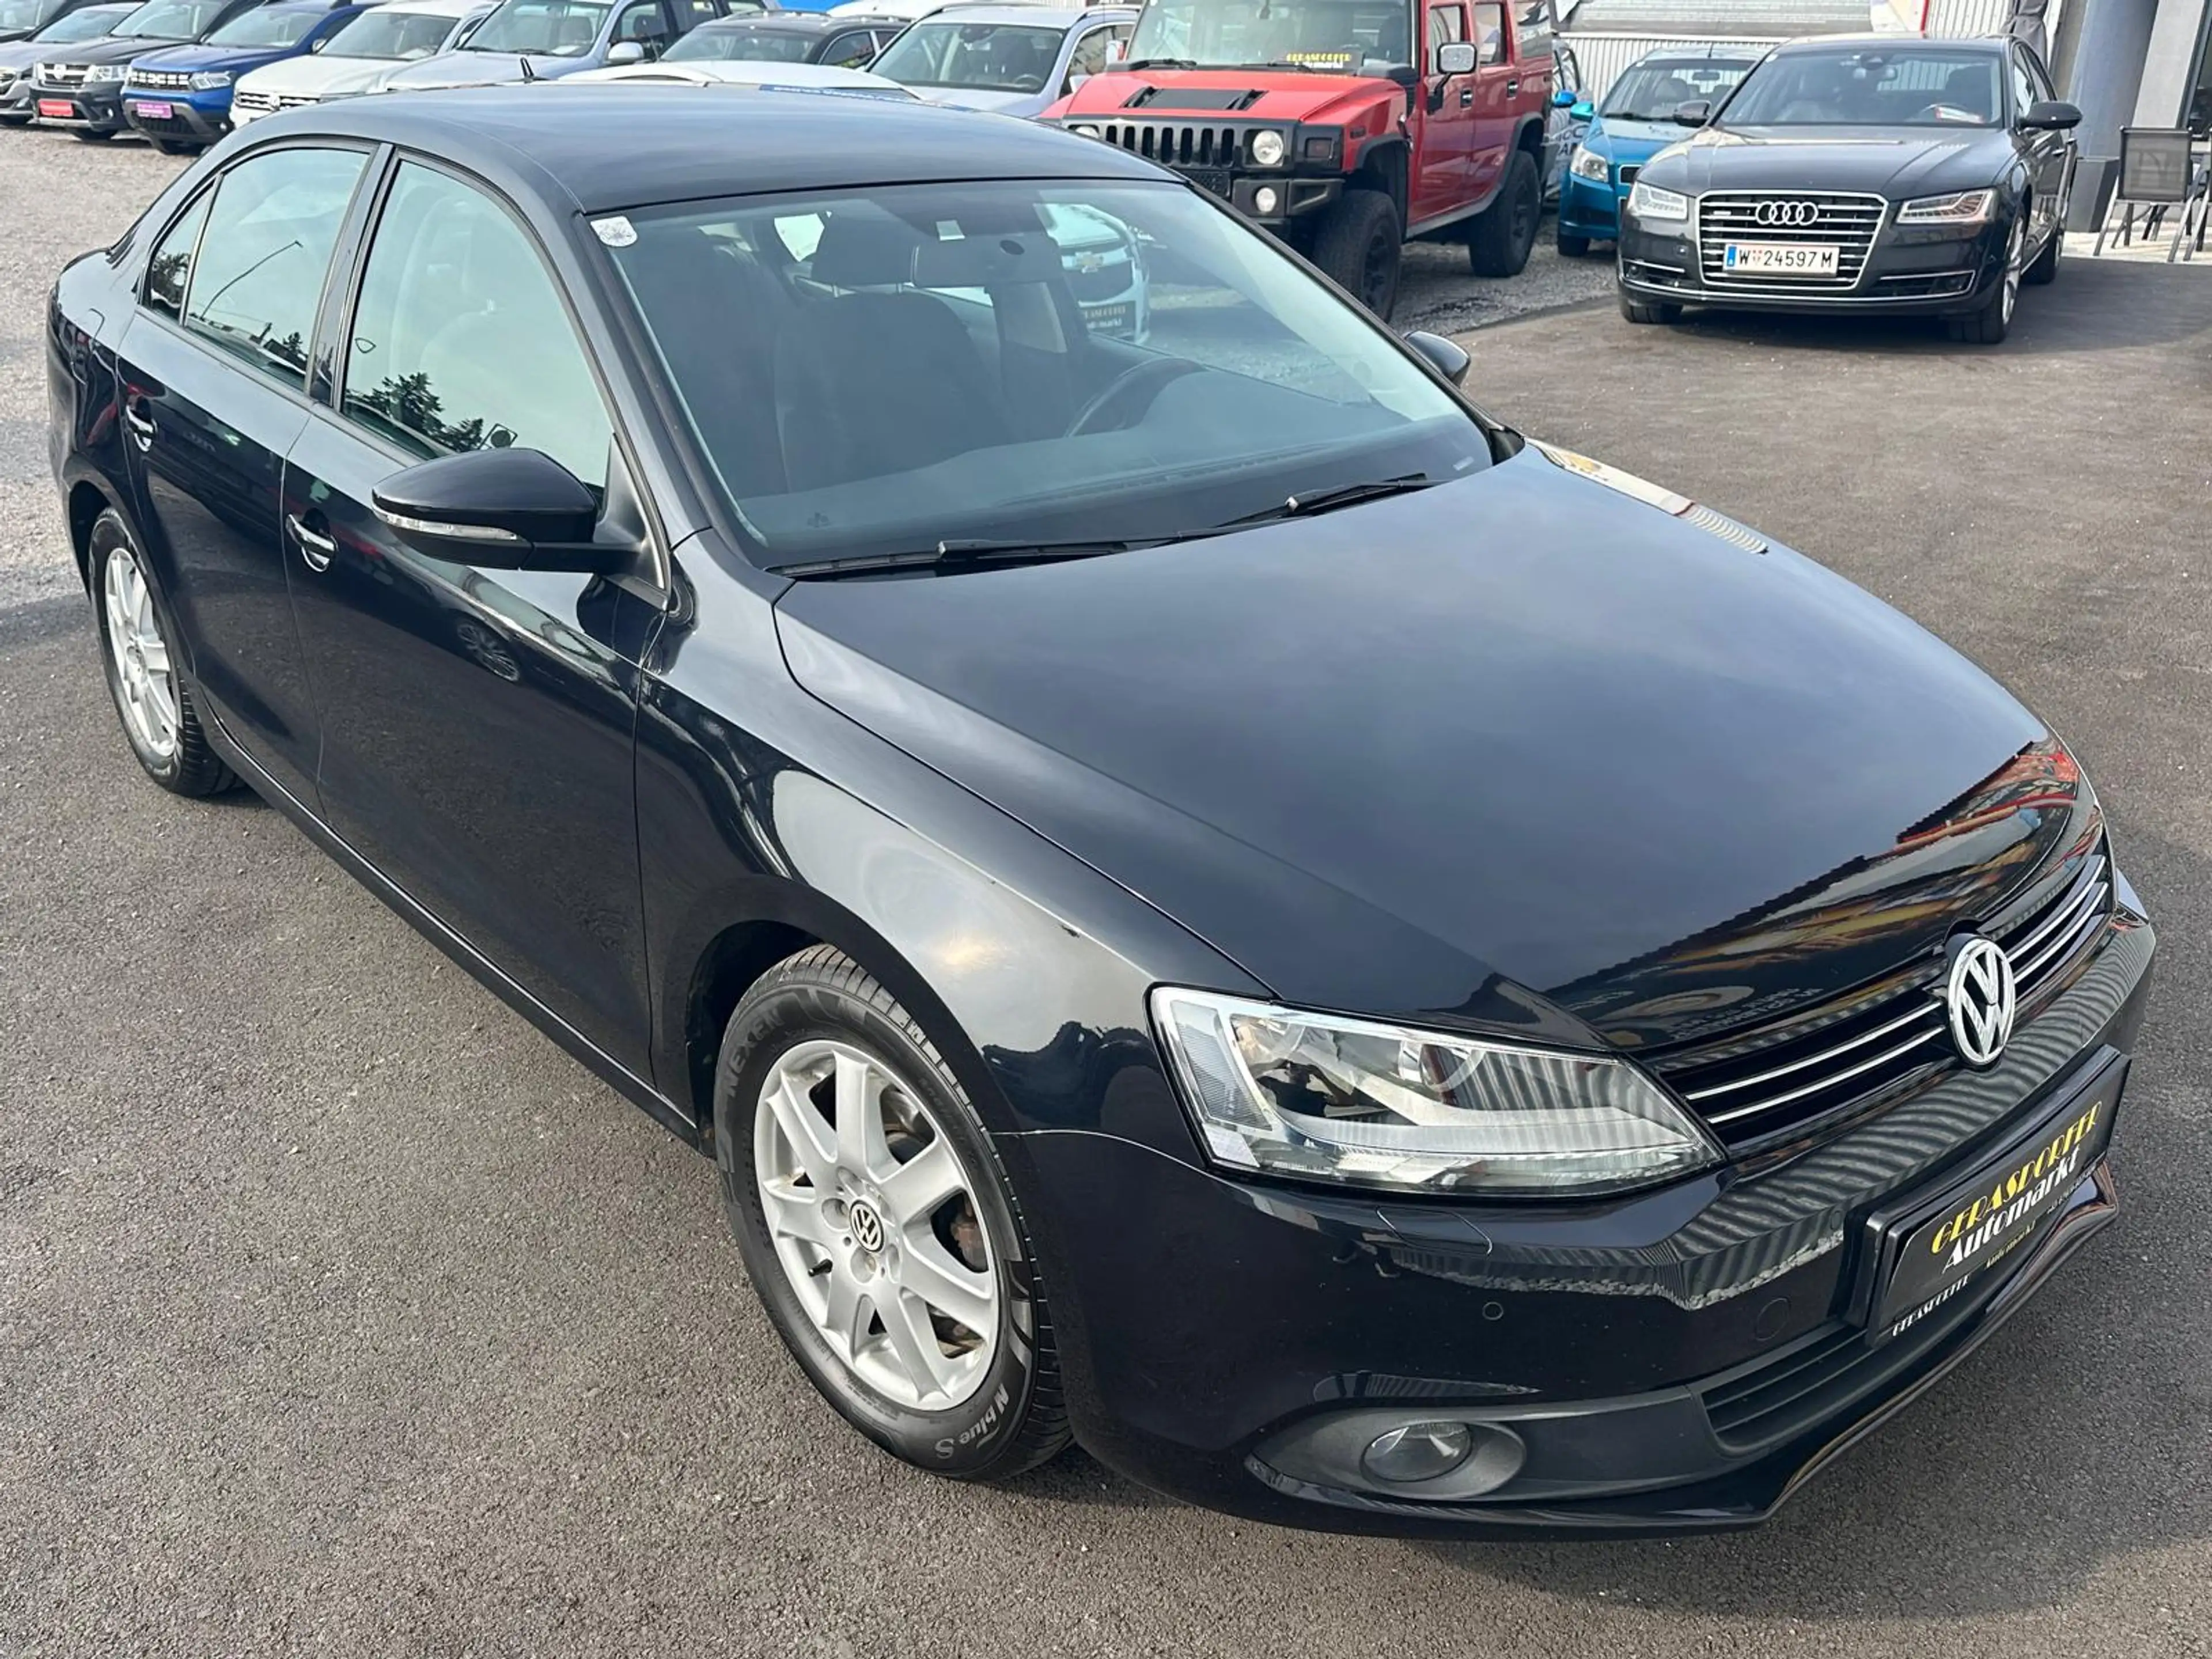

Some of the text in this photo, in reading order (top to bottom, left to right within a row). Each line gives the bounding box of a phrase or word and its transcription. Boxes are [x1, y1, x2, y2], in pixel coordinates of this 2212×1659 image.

[1738, 249, 1833, 268] W 24597 M
[726, 1007, 786, 1098] NEXEN
[1931, 1100, 2103, 1255] GERASDORFER
[1941, 1144, 2081, 1275] Automarkt
[934, 1438, 955, 1460] S
[959, 1405, 997, 1445] blue
